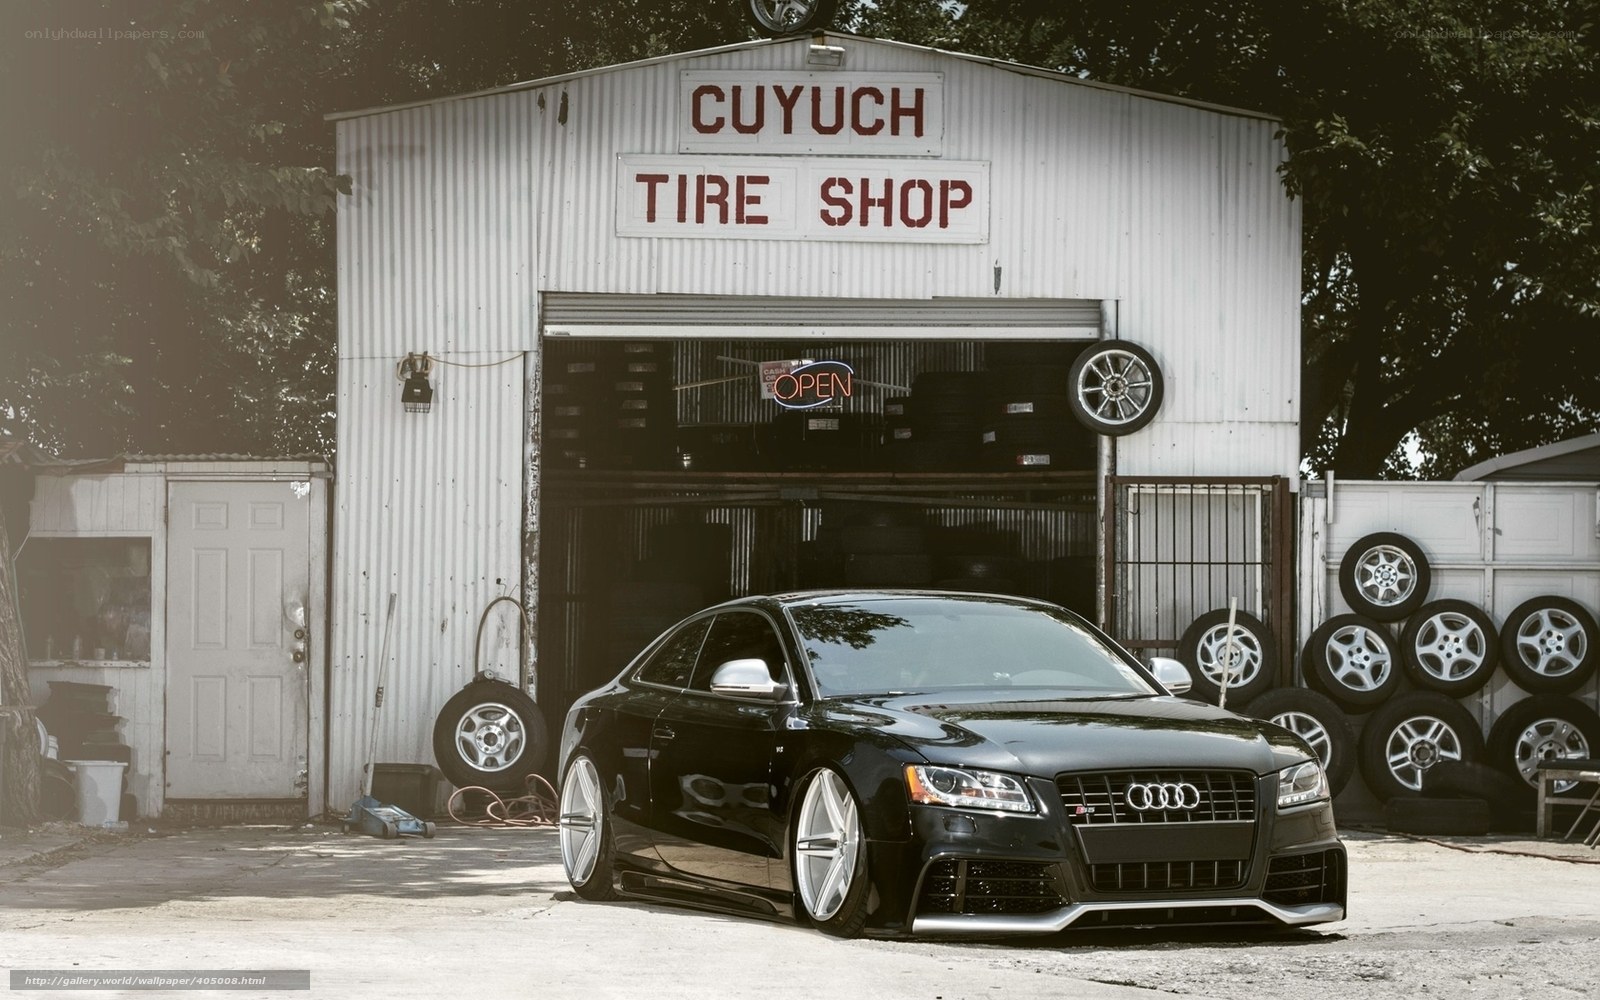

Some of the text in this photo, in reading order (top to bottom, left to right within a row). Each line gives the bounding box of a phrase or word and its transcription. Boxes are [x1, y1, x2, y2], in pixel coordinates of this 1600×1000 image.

[691, 84, 924, 138] CUYUCH
[635, 173, 973, 229] TIRE SHOP
[774, 372, 851, 399] OPEN
